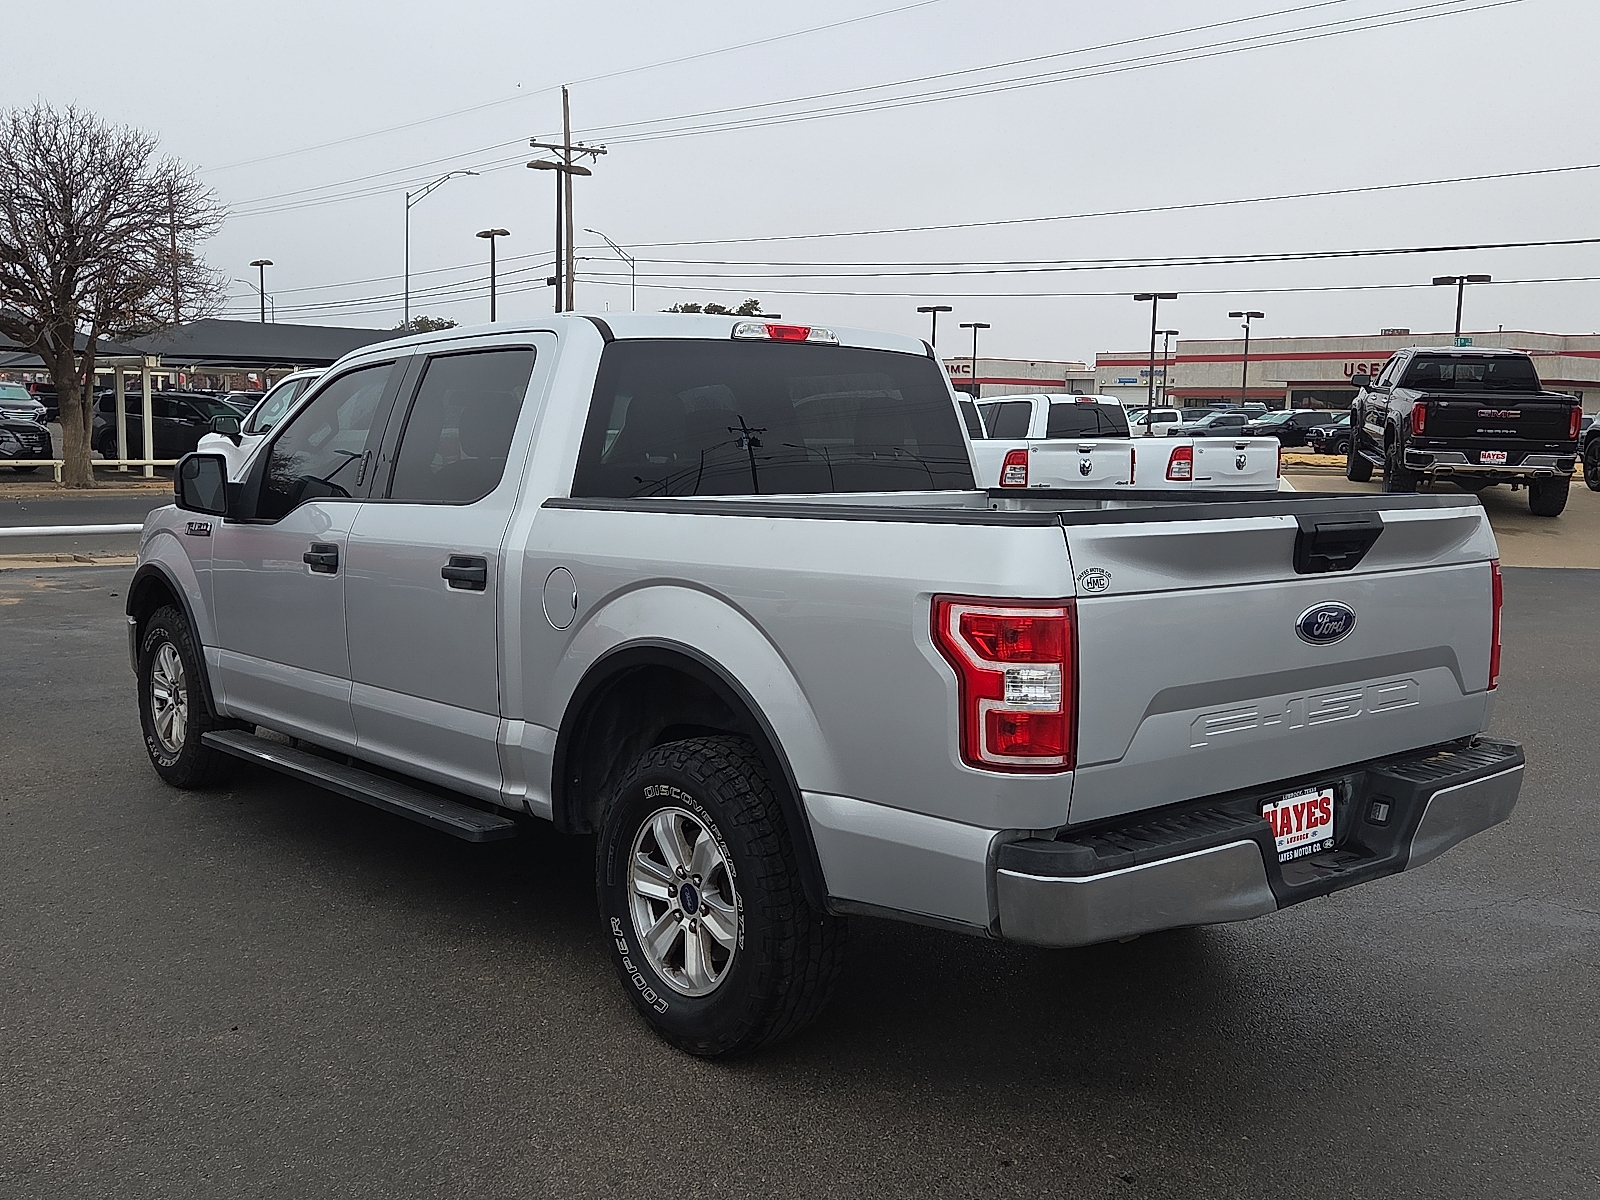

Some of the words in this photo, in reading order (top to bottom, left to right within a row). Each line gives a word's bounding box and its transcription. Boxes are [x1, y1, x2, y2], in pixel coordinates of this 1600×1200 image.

[1343, 362, 1386, 377] USE
[1477, 409, 1521, 419] GMC
[1481, 452, 1506, 460] HAYES
[1313, 611, 1346, 636] Ford
[1190, 677, 1420, 749] F-150
[1264, 797, 1331, 838] HAYES
[643, 784, 737, 878] DISCOVERER
[1294, 846, 1312, 858] MOTOR
[610, 916, 669, 1015] COOPER
